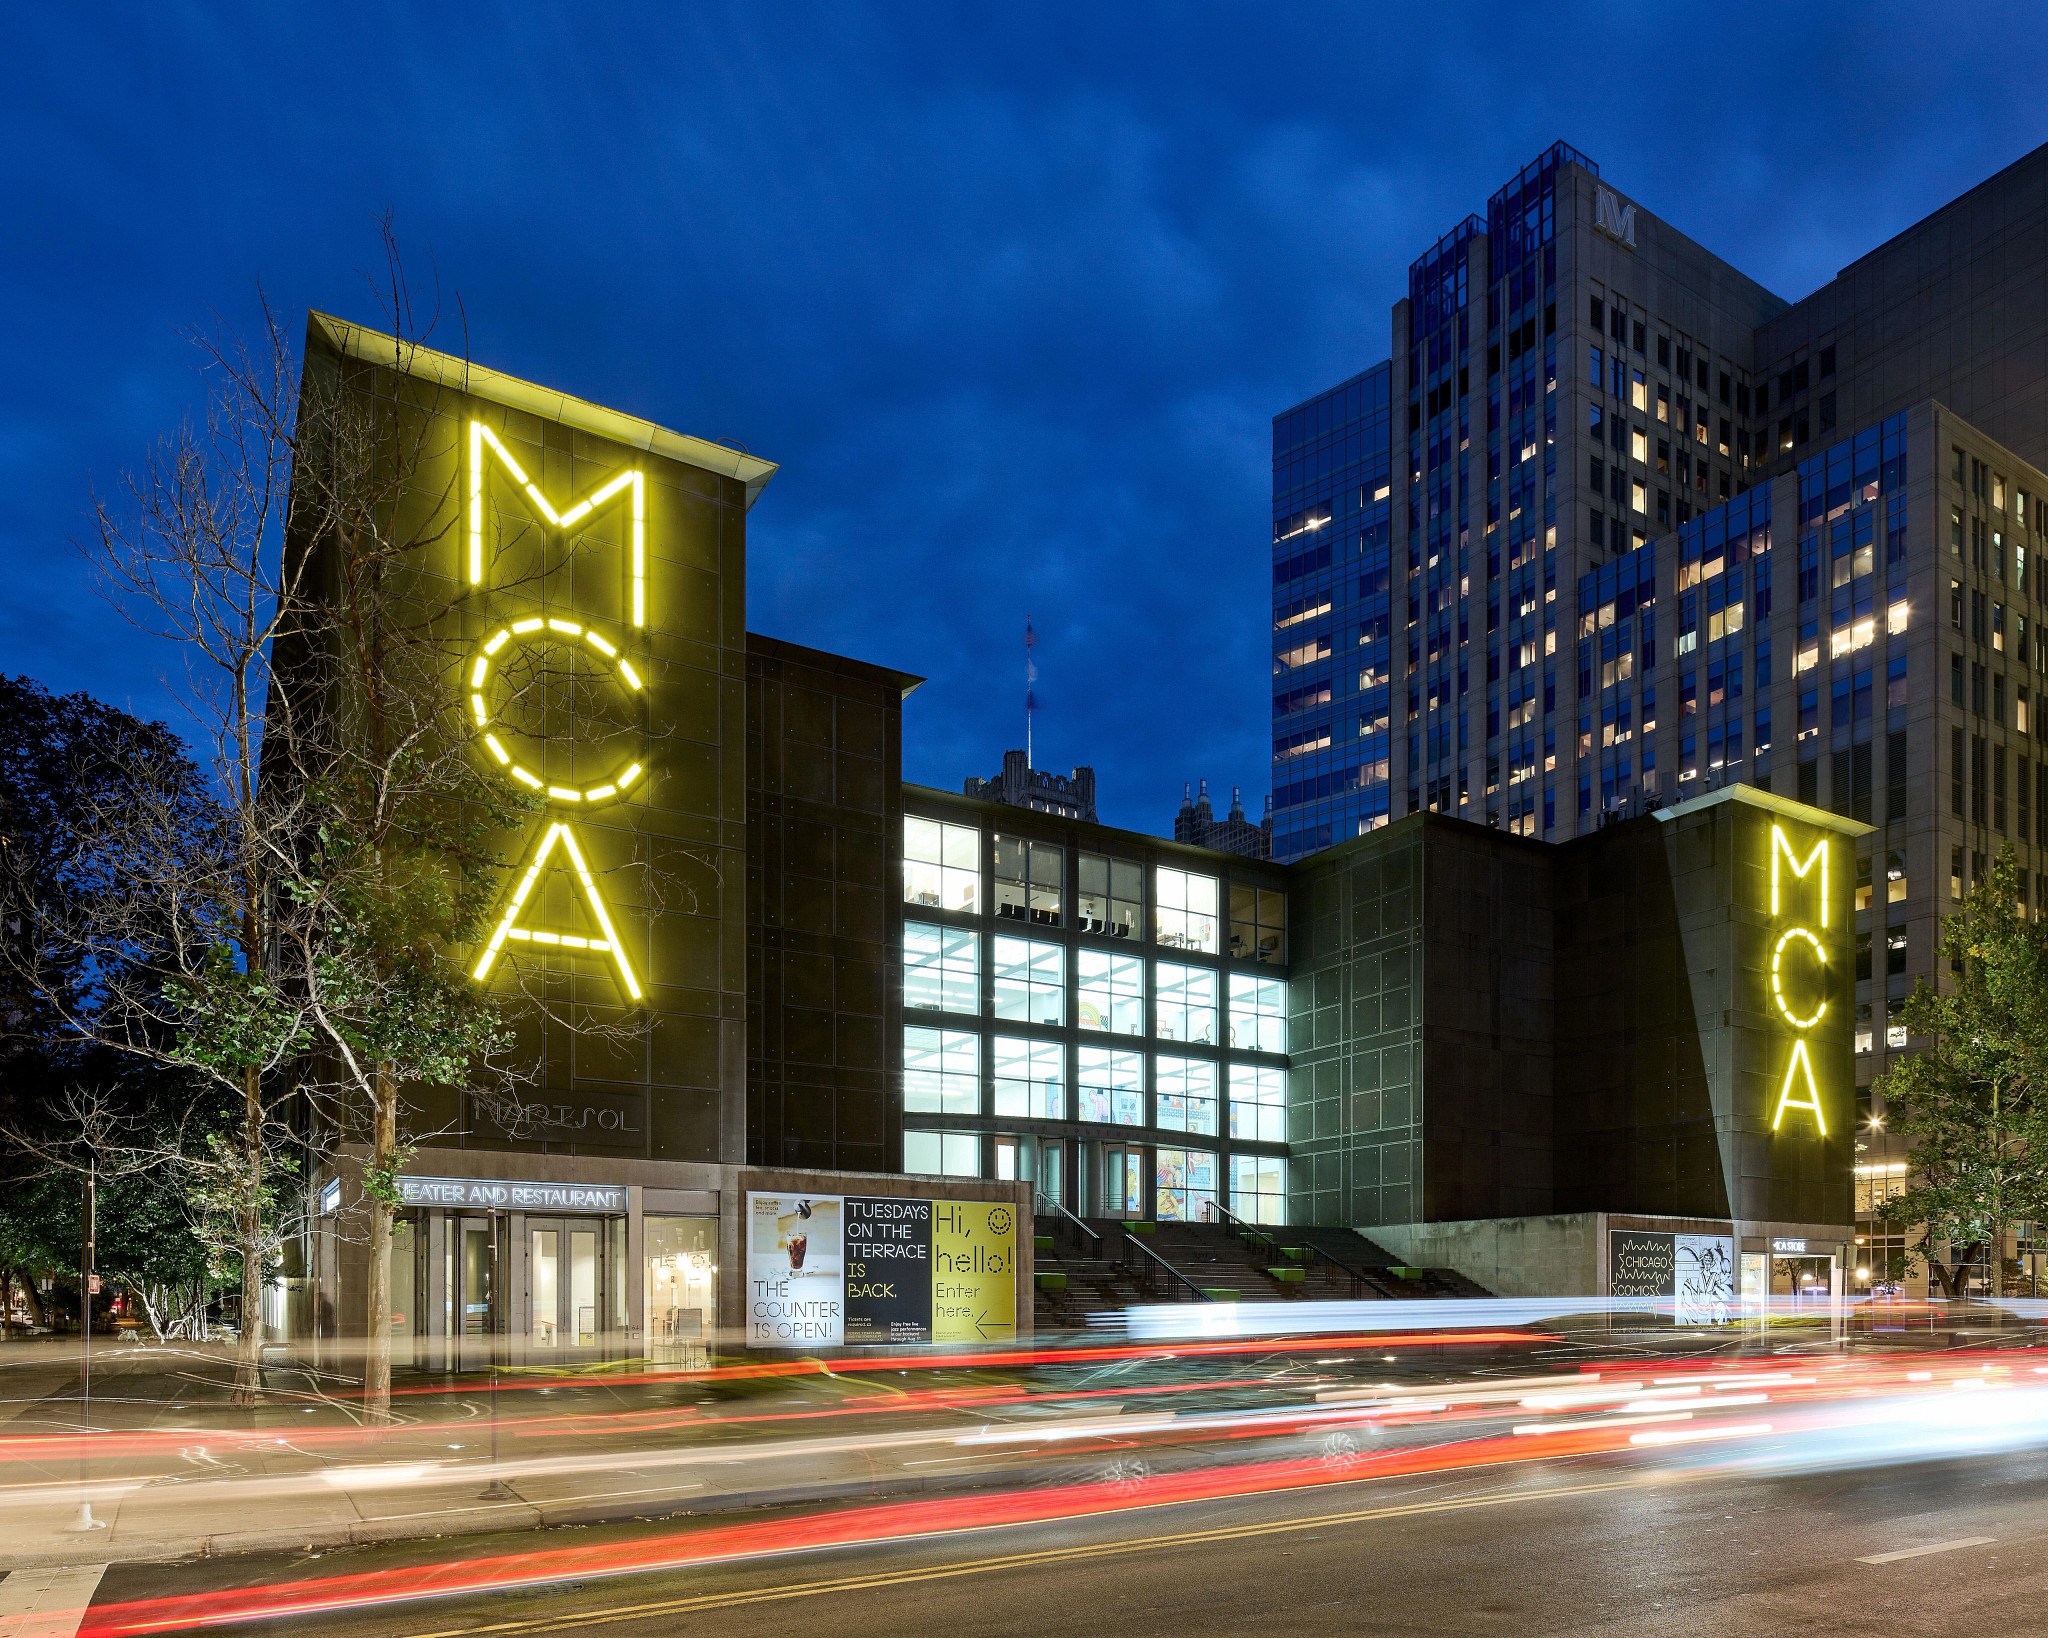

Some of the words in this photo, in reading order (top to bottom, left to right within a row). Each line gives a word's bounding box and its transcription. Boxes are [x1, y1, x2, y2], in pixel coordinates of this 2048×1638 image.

[394, 1183, 465, 1201] HEATER
[469, 1186, 508, 1202] AND
[512, 1187, 621, 1207] RESTAURANT
[847, 1202, 929, 1220] TUESDAYS
[936, 1204, 971, 1238] Hi,
[847, 1222, 873, 1239] ON
[877, 1222, 912, 1240] THE
[847, 1242, 927, 1259] TERRACE
[1787, 1241, 1806, 1252] STORE
[936, 1244, 1011, 1274] hello!
[1625, 1256, 1668, 1269] CHICAGO
[847, 1262, 866, 1278] IS
[753, 1279, 789, 1298] THE
[847, 1282, 897, 1299] BACK.
[936, 1282, 981, 1299] Enter
[753, 1301, 840, 1319] COUNTER
[936, 1302, 975, 1318] here.
[753, 1322, 771, 1339] IS
[776, 1321, 833, 1339] OPEN!
